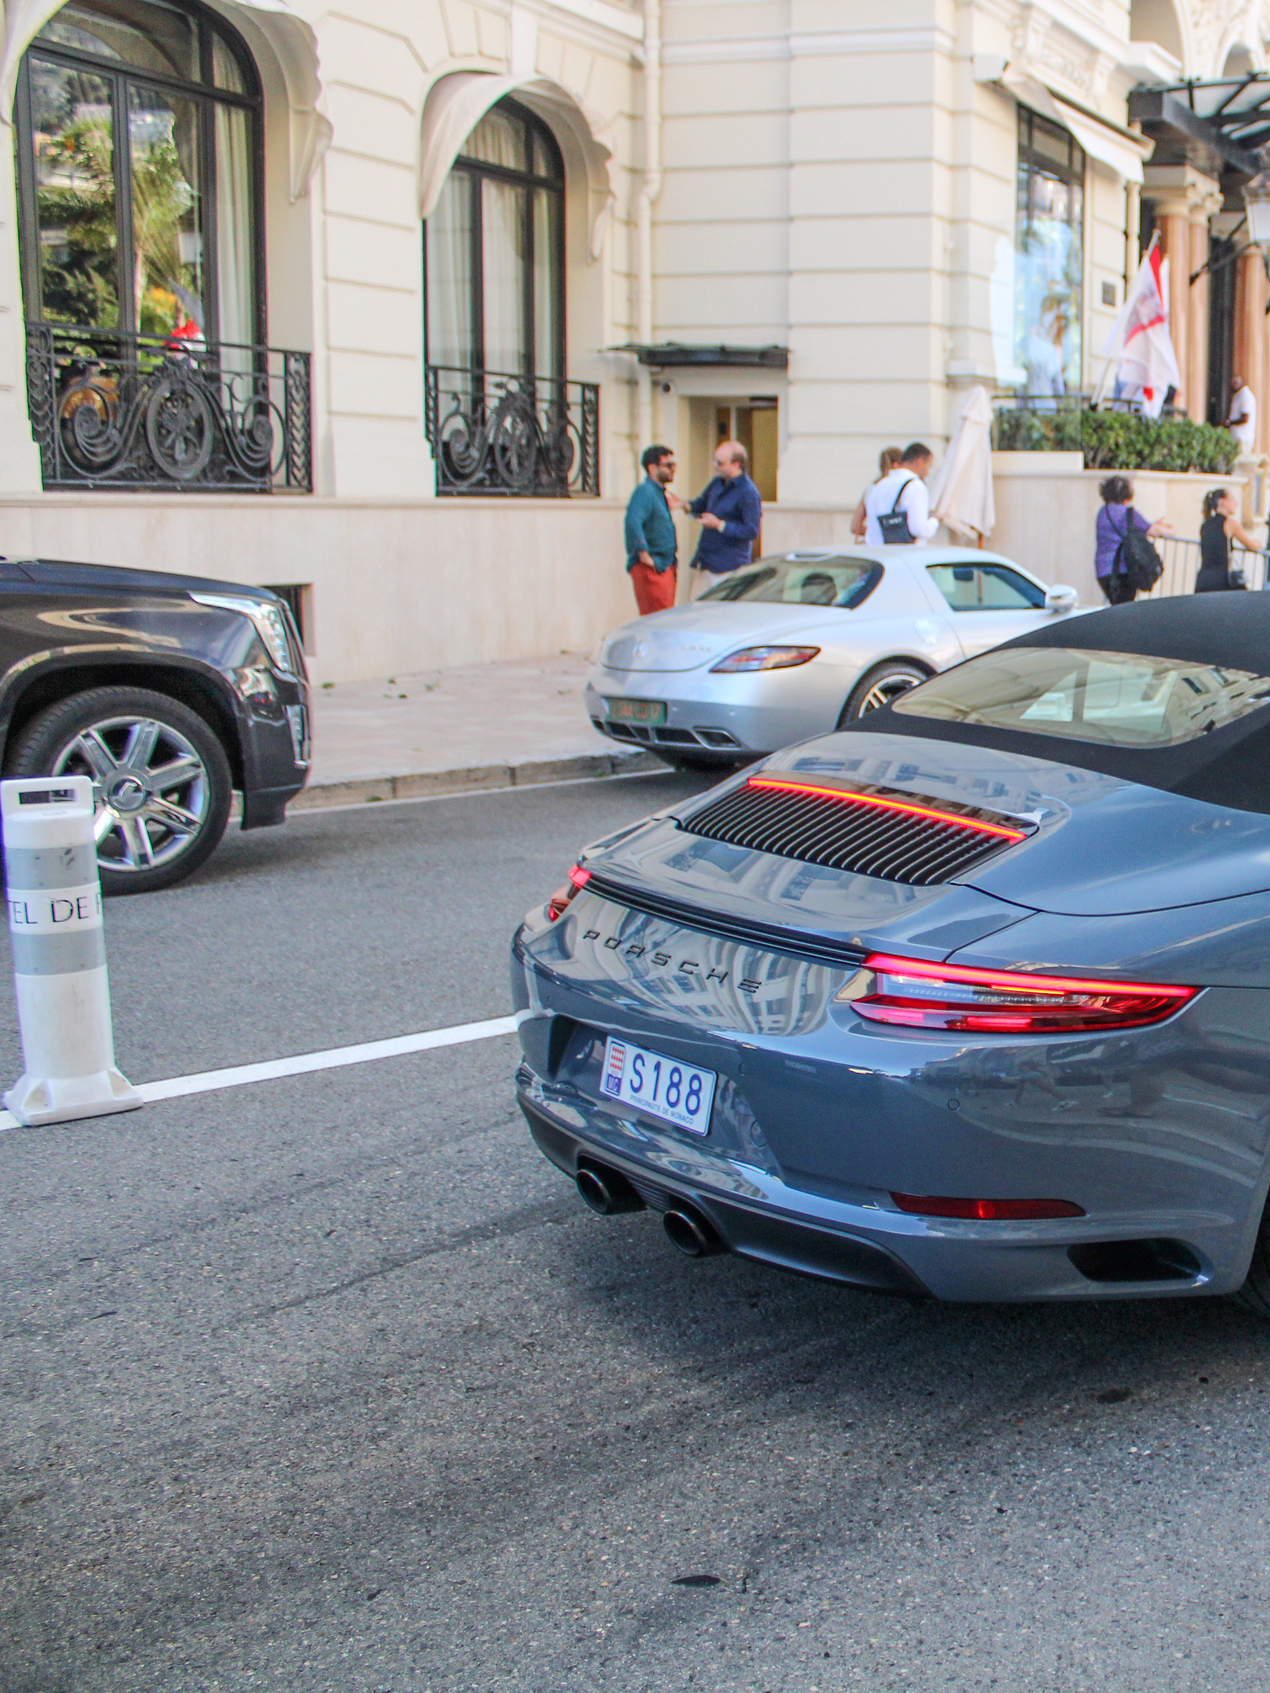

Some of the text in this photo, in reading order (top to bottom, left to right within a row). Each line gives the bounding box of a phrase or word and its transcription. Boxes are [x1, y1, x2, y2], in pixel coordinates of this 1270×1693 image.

[50, 896, 89, 923] DE
[583, 929, 762, 994] PORSCHE
[607, 1075, 621, 1093] MC
[629, 1053, 702, 1116] S188
[662, 1107, 669, 1116] DE
[670, 1110, 694, 1125] MONACO
